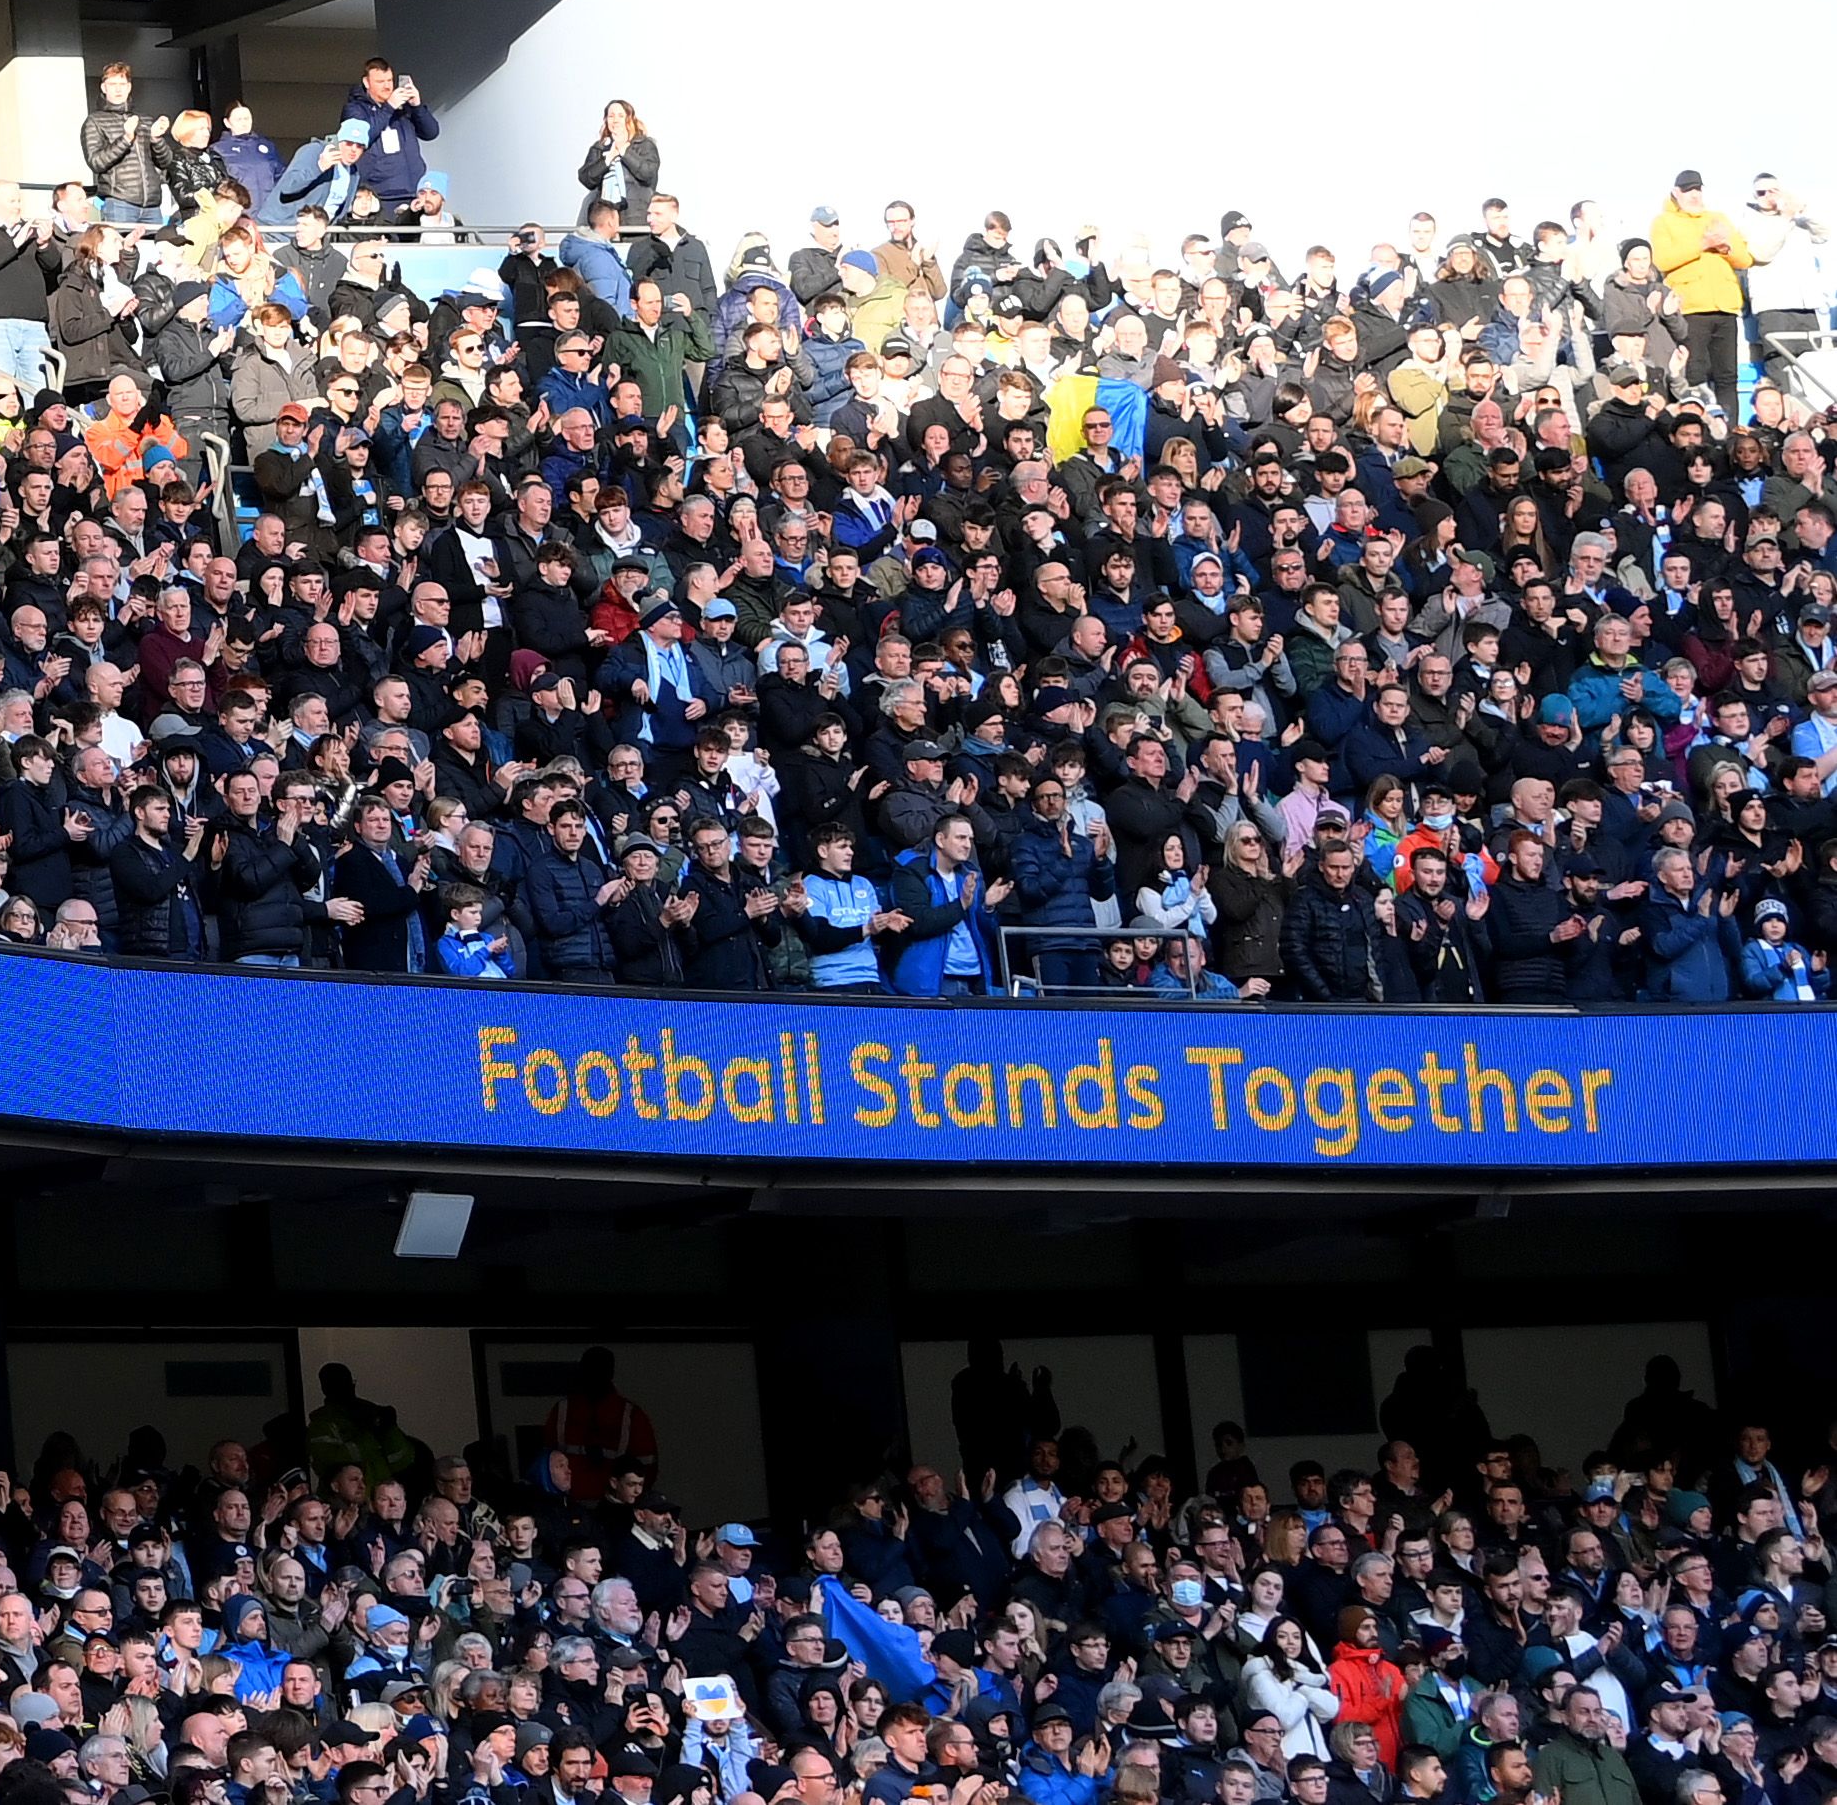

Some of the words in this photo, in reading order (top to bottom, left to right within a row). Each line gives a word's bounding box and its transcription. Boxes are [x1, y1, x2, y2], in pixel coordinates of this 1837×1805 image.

[478, 1027, 825, 1125] Football
[851, 1038, 1164, 1130] Stands
[1186, 1043, 1612, 1157] Together
